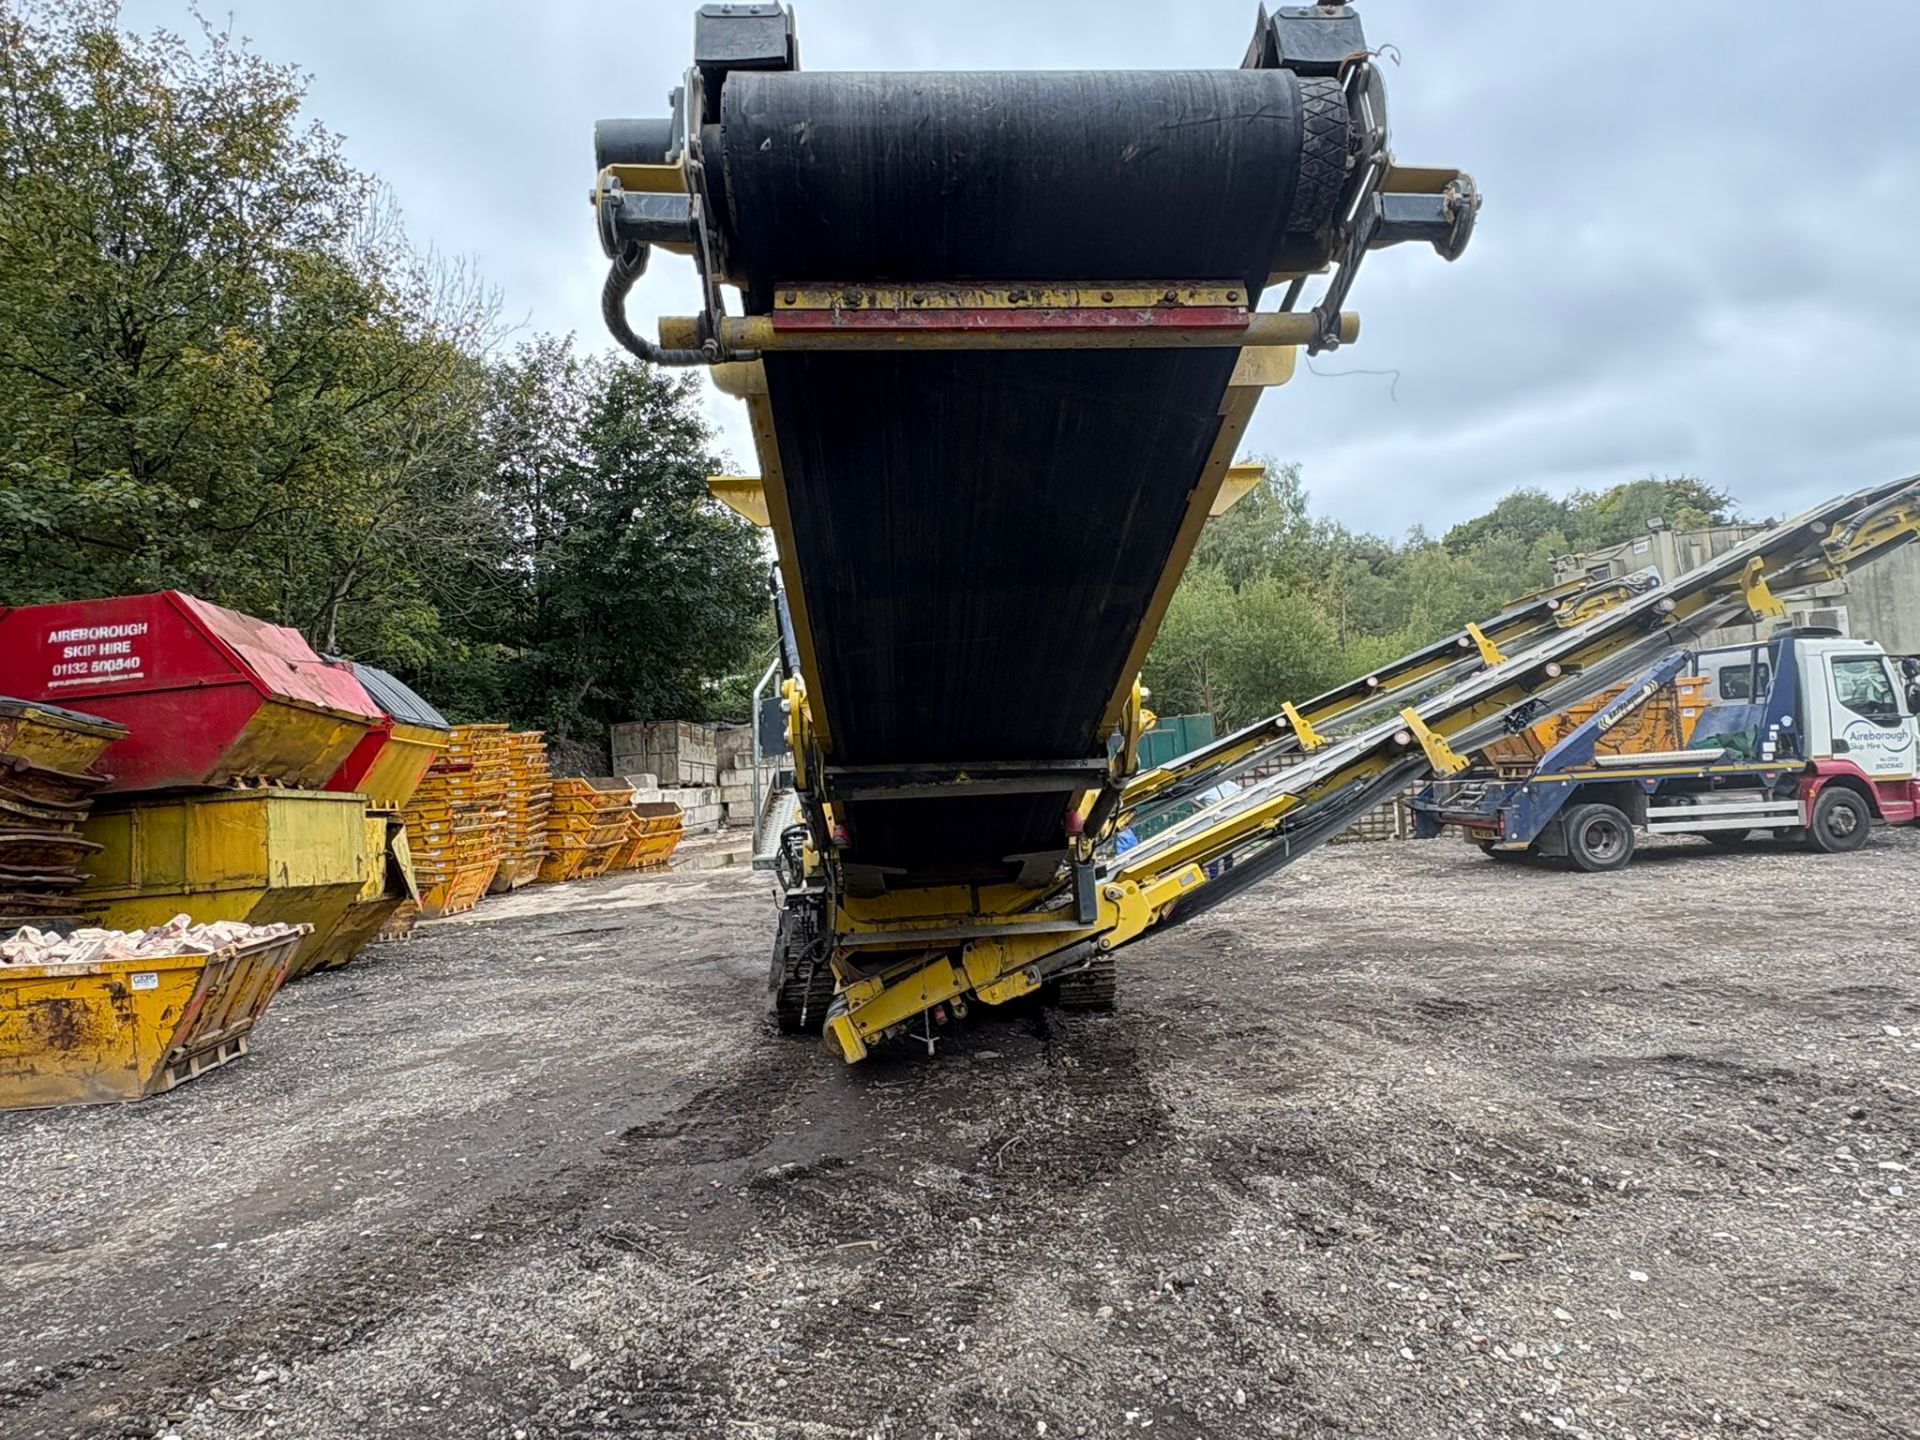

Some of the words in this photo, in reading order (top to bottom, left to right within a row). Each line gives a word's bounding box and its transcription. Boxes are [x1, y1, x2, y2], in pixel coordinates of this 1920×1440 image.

[48, 623, 148, 643] AIREBOROUGH
[63, 644, 96, 658] SKIP
[100, 640, 131, 655] HIRE
[53, 661, 88, 676] 01132
[91, 657, 140, 672] 500540
[1850, 729, 1908, 741] Aireborough
